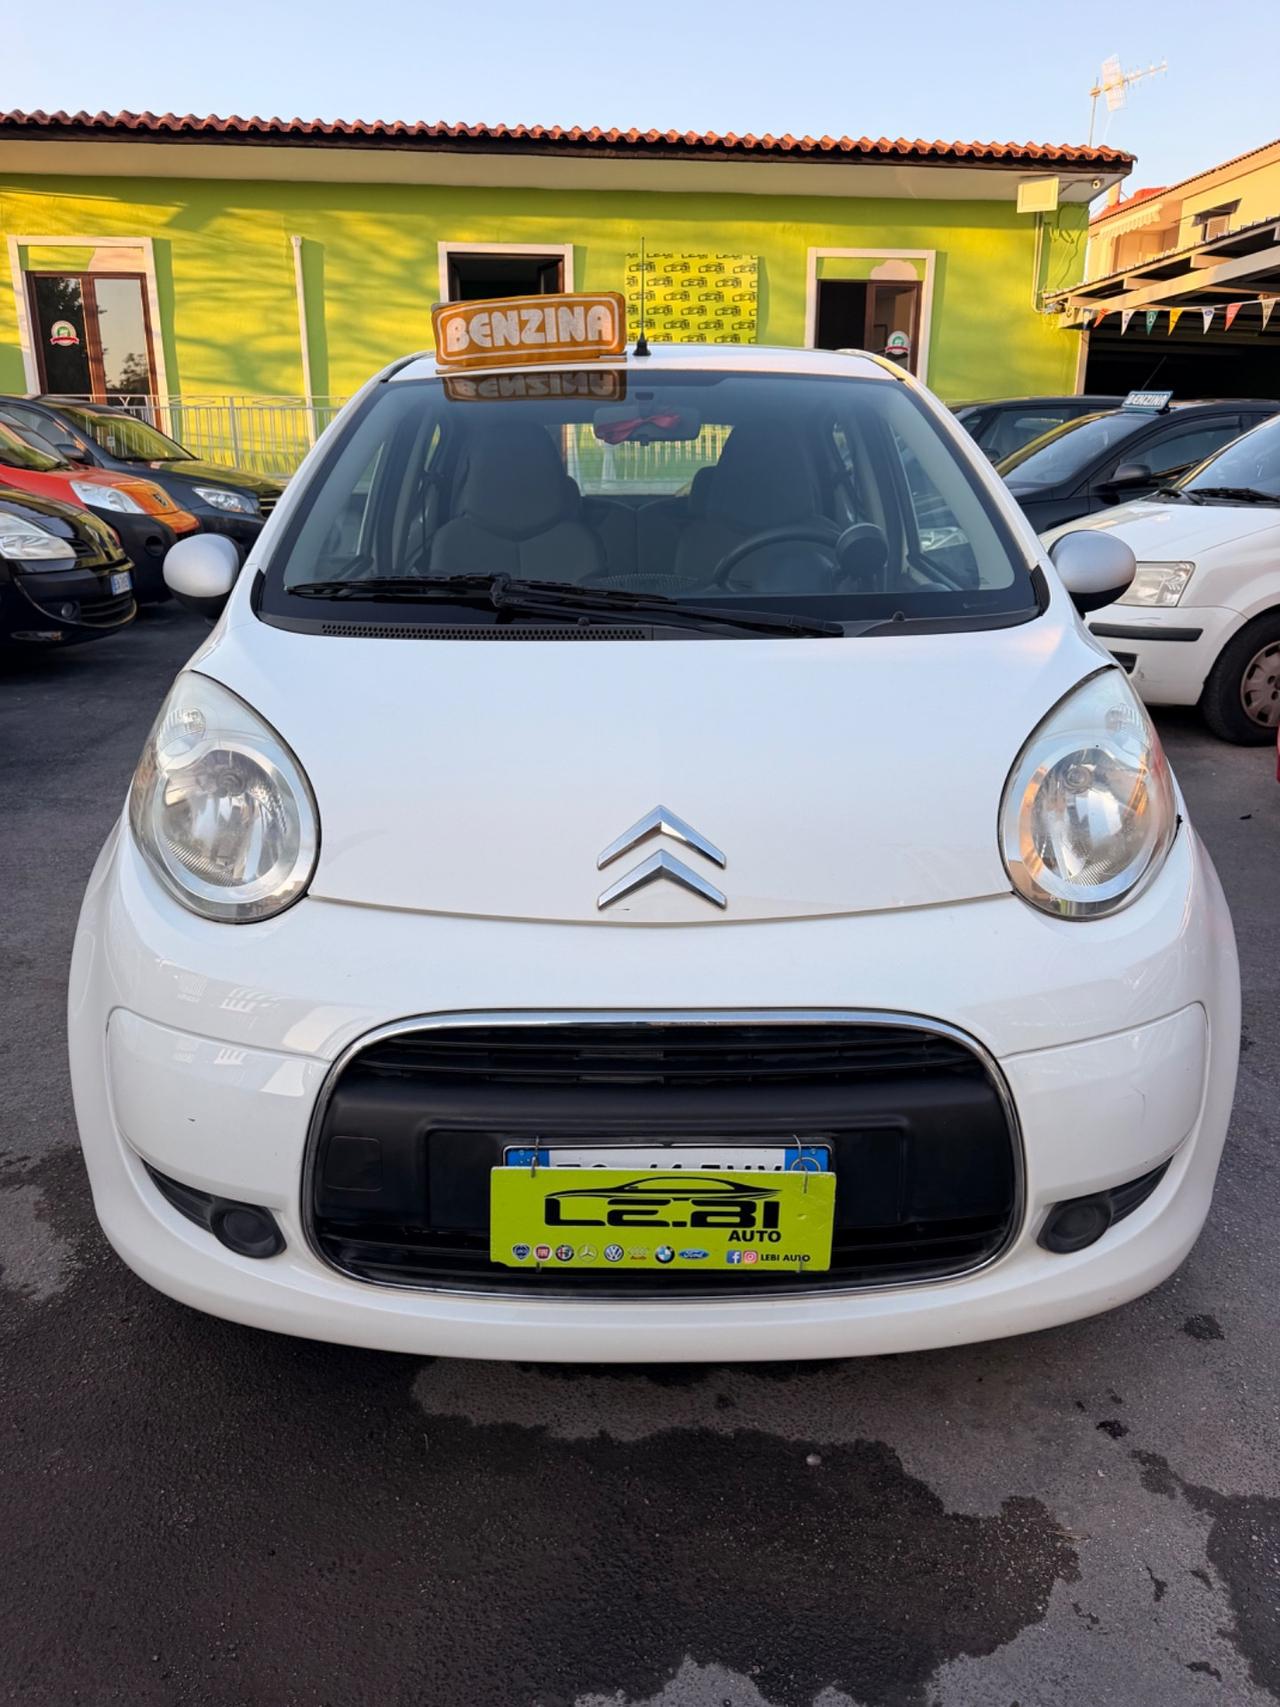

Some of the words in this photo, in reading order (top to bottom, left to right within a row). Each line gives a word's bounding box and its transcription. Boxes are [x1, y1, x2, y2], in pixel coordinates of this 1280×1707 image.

[446, 305, 613, 352] BENZINA
[728, 1230, 782, 1242] AUTO
[761, 1254, 780, 1262] LEBI
[783, 1254, 811, 1262] AUTO
